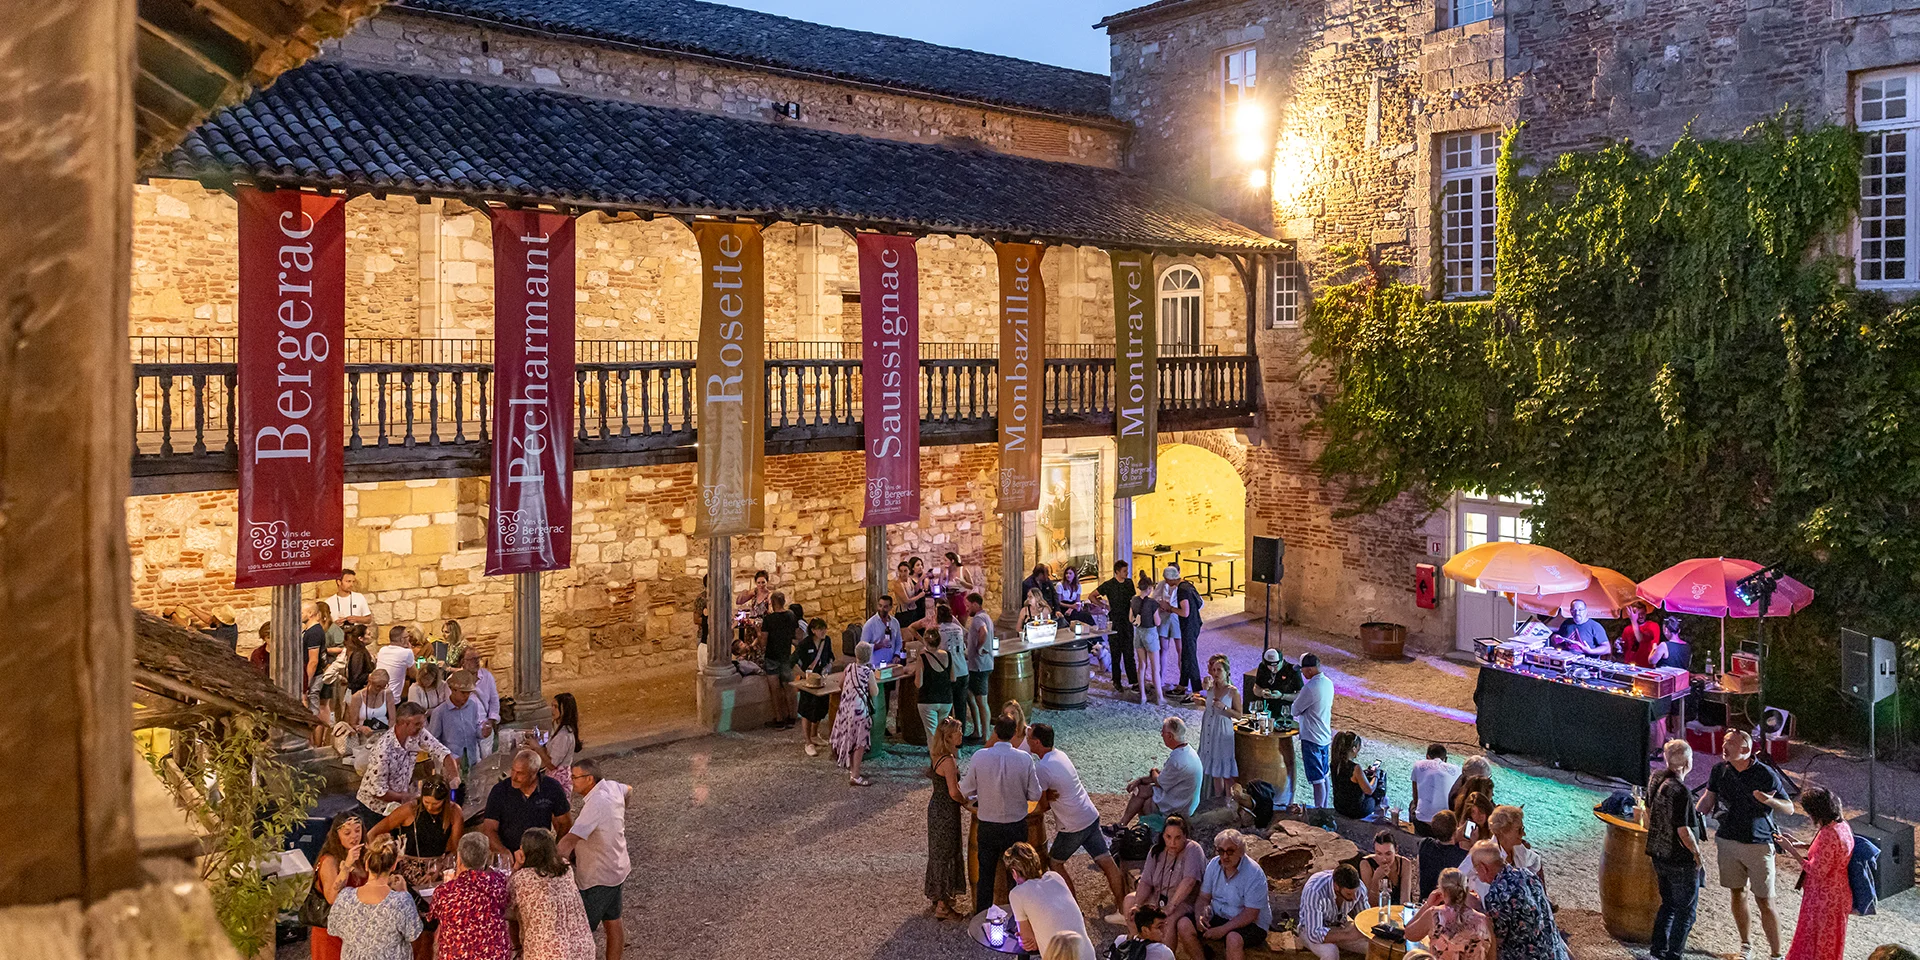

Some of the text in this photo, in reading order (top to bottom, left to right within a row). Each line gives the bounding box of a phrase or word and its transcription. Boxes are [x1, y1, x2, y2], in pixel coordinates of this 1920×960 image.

[705, 233, 744, 408] Rosette
[254, 210, 330, 465] Bergerac
[872, 248, 909, 459] Saussignac
[1004, 256, 1030, 453] Monbazillac
[1118, 258, 1145, 439] Montravel
[507, 231, 550, 488] Pécharmant
[884, 489, 914, 499] Bergerac
[722, 497, 758, 508] Bergerac
[281, 530, 299, 538] Vins
[522, 525, 565, 537] Bergerac
[281, 538, 335, 551] Bergerac
[521, 536, 545, 545] Duras
[281, 550, 311, 560] Duras
[261, 561, 291, 569] SUD-OUEST
